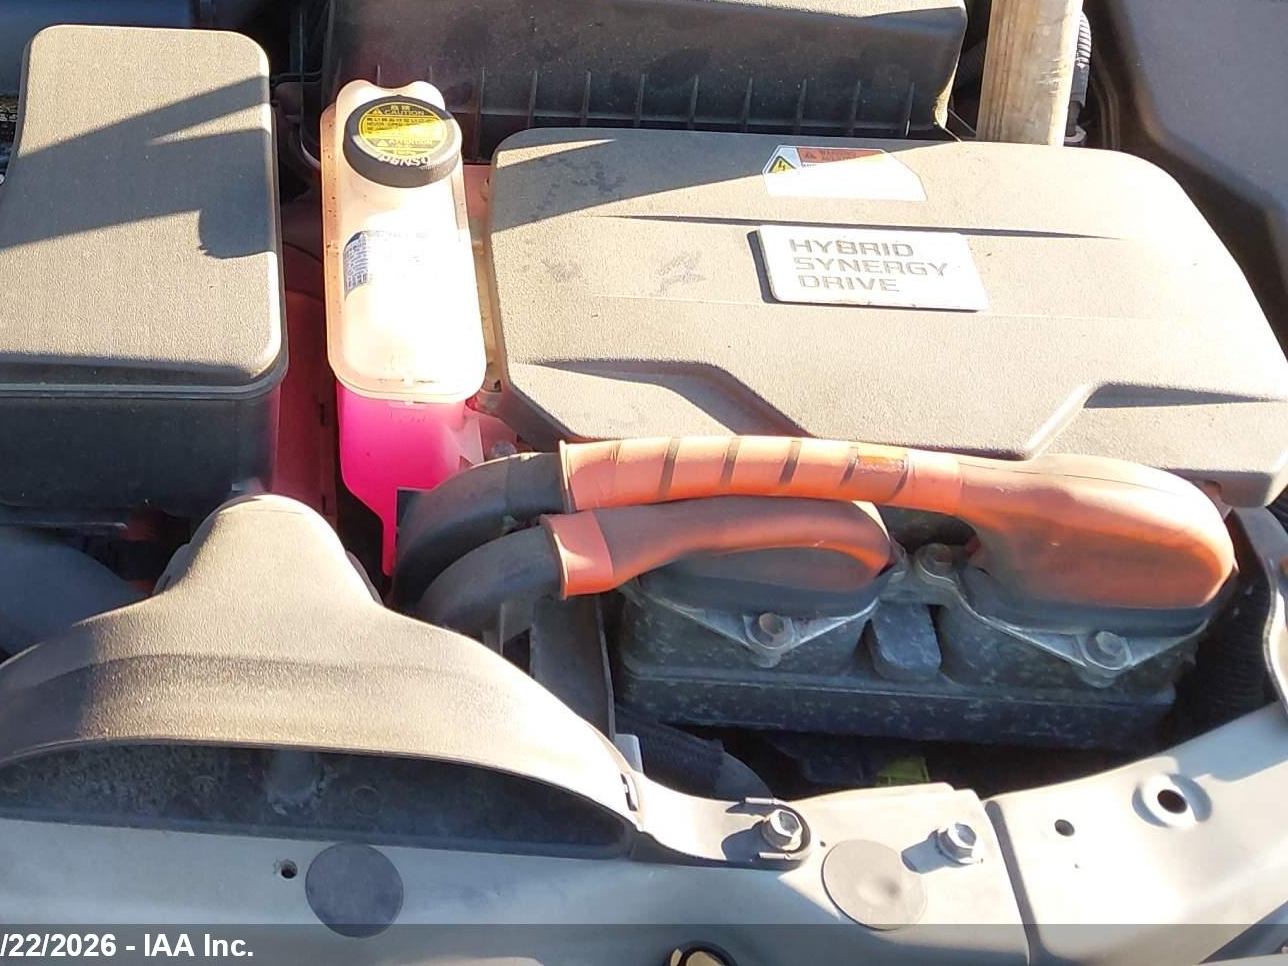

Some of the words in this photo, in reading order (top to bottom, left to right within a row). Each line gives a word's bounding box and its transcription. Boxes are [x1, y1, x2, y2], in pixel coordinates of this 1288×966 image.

[378, 153, 430, 167] DENSO
[789, 238, 914, 257] HYBRID
[793, 257, 948, 277] SYNERGY
[798, 274, 900, 292] DRIVE
